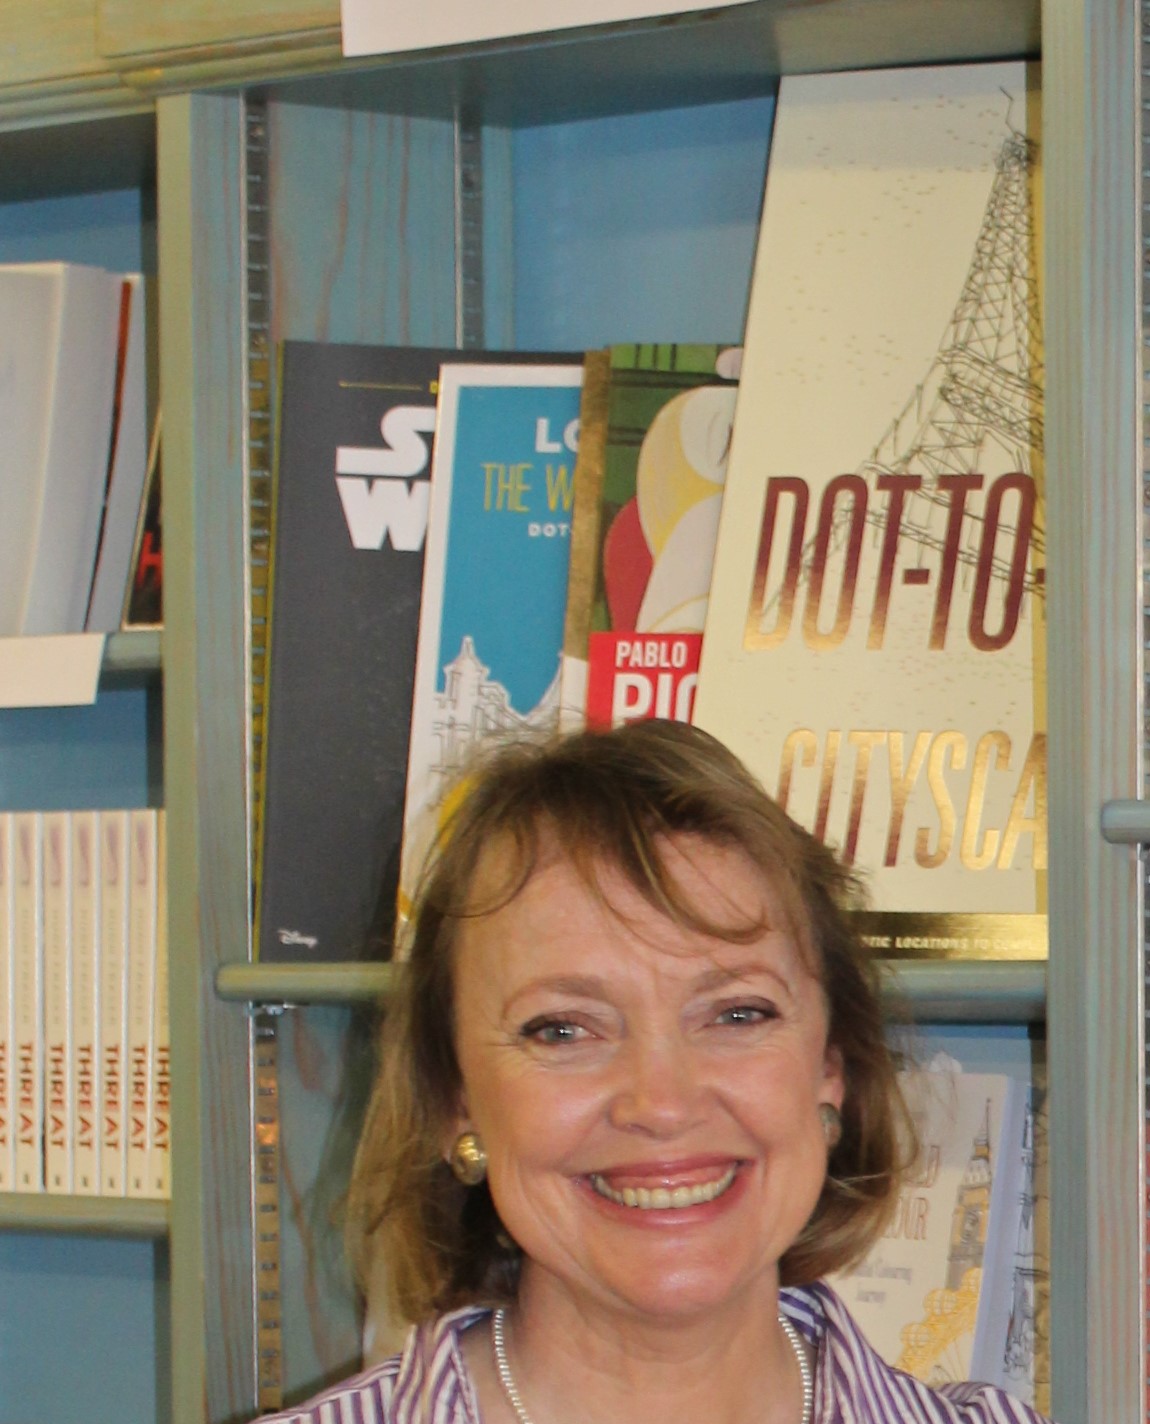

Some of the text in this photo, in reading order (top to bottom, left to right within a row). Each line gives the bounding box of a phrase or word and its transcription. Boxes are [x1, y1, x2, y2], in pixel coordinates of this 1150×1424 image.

[482, 463, 533, 512] THE
[615, 641, 688, 668] PABLO
[895, 936, 969, 950] LOCATIONS
[20, 1042, 33, 1146] THREAT
[155, 1046, 170, 1151] THREAT
